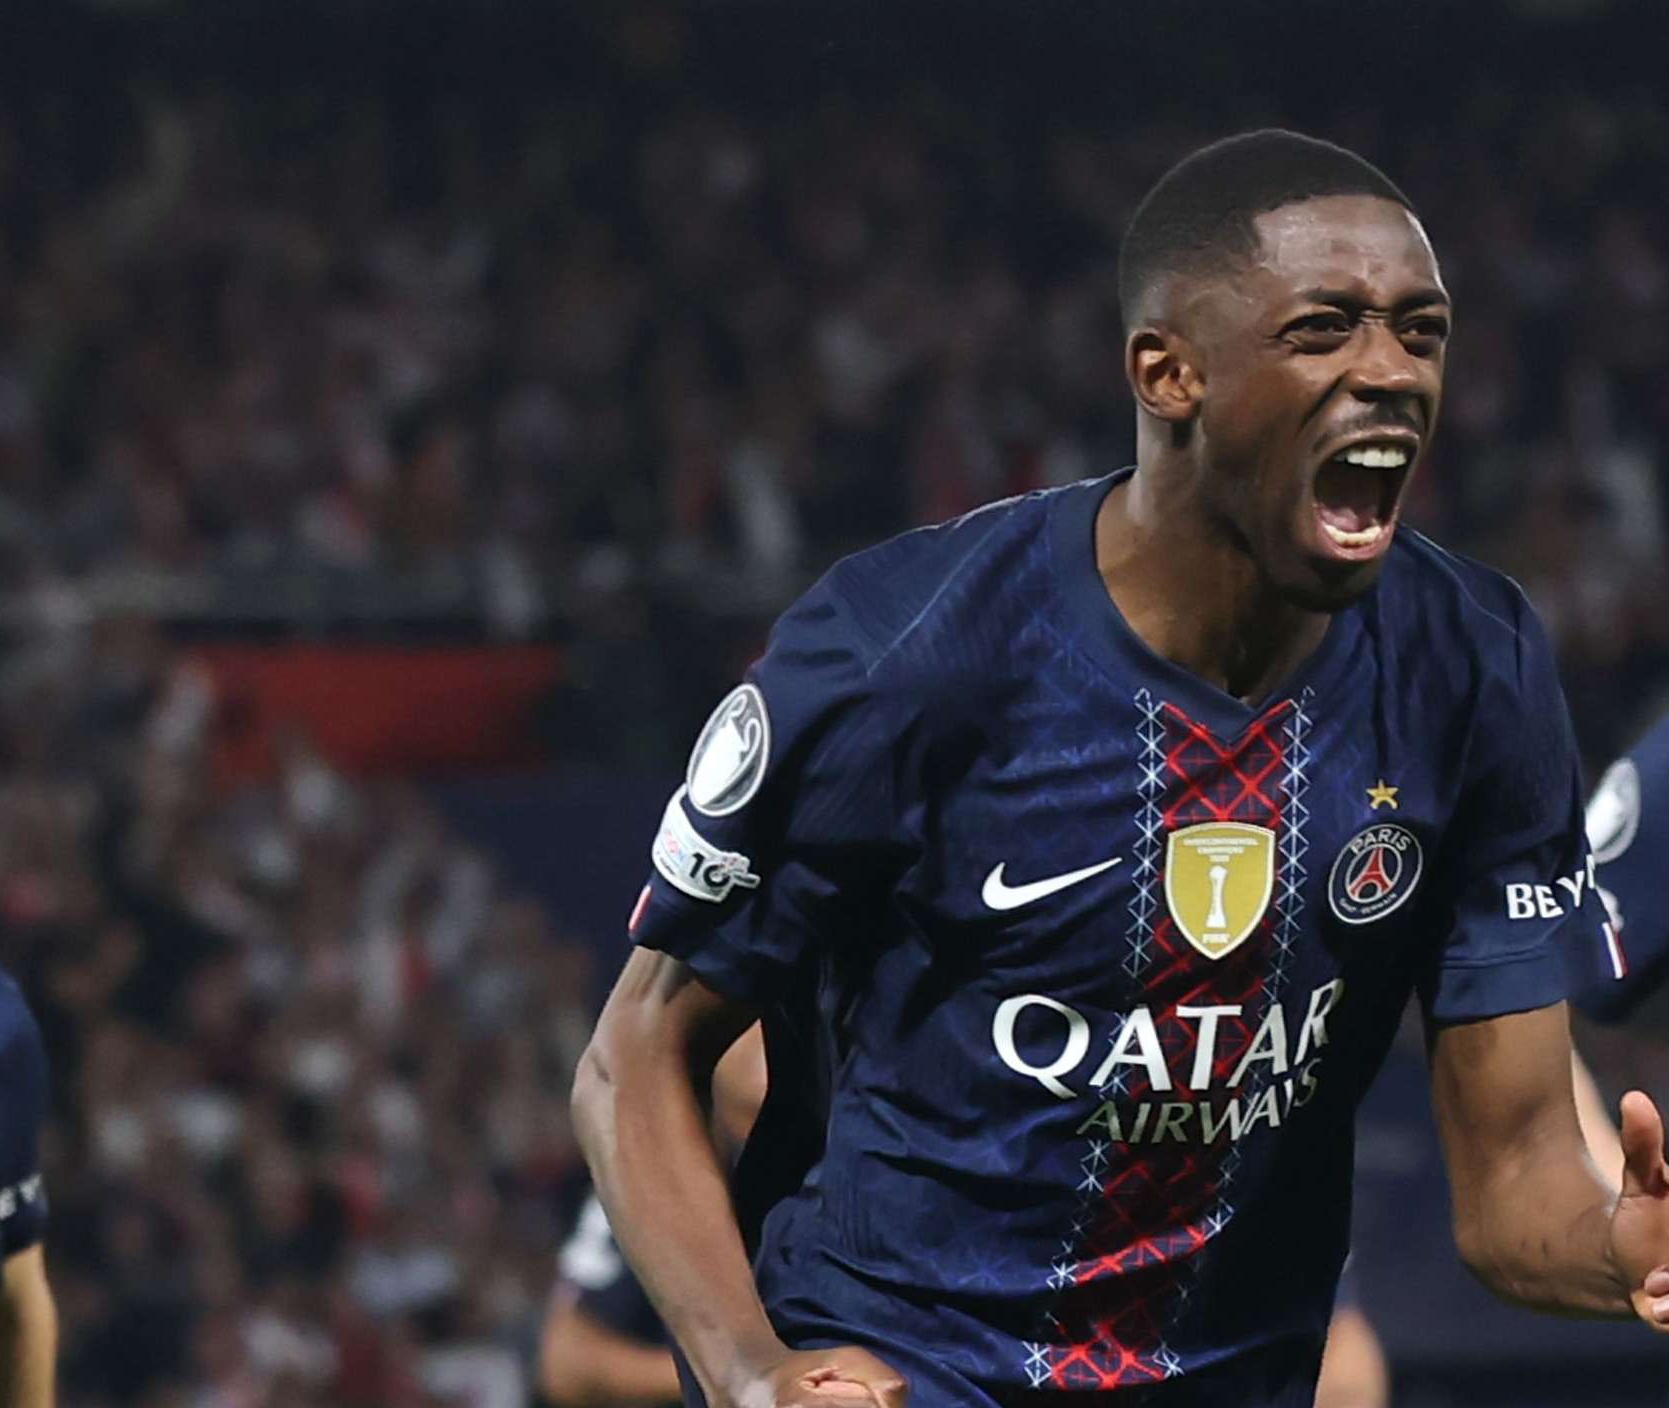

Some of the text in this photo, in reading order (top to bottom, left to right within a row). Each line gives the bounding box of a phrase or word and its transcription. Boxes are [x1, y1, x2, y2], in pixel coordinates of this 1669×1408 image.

[1350, 828, 1411, 855] PARIS
[992, 977, 1344, 1098] QATAR
[1077, 1058, 1320, 1144] AIRWAYS
